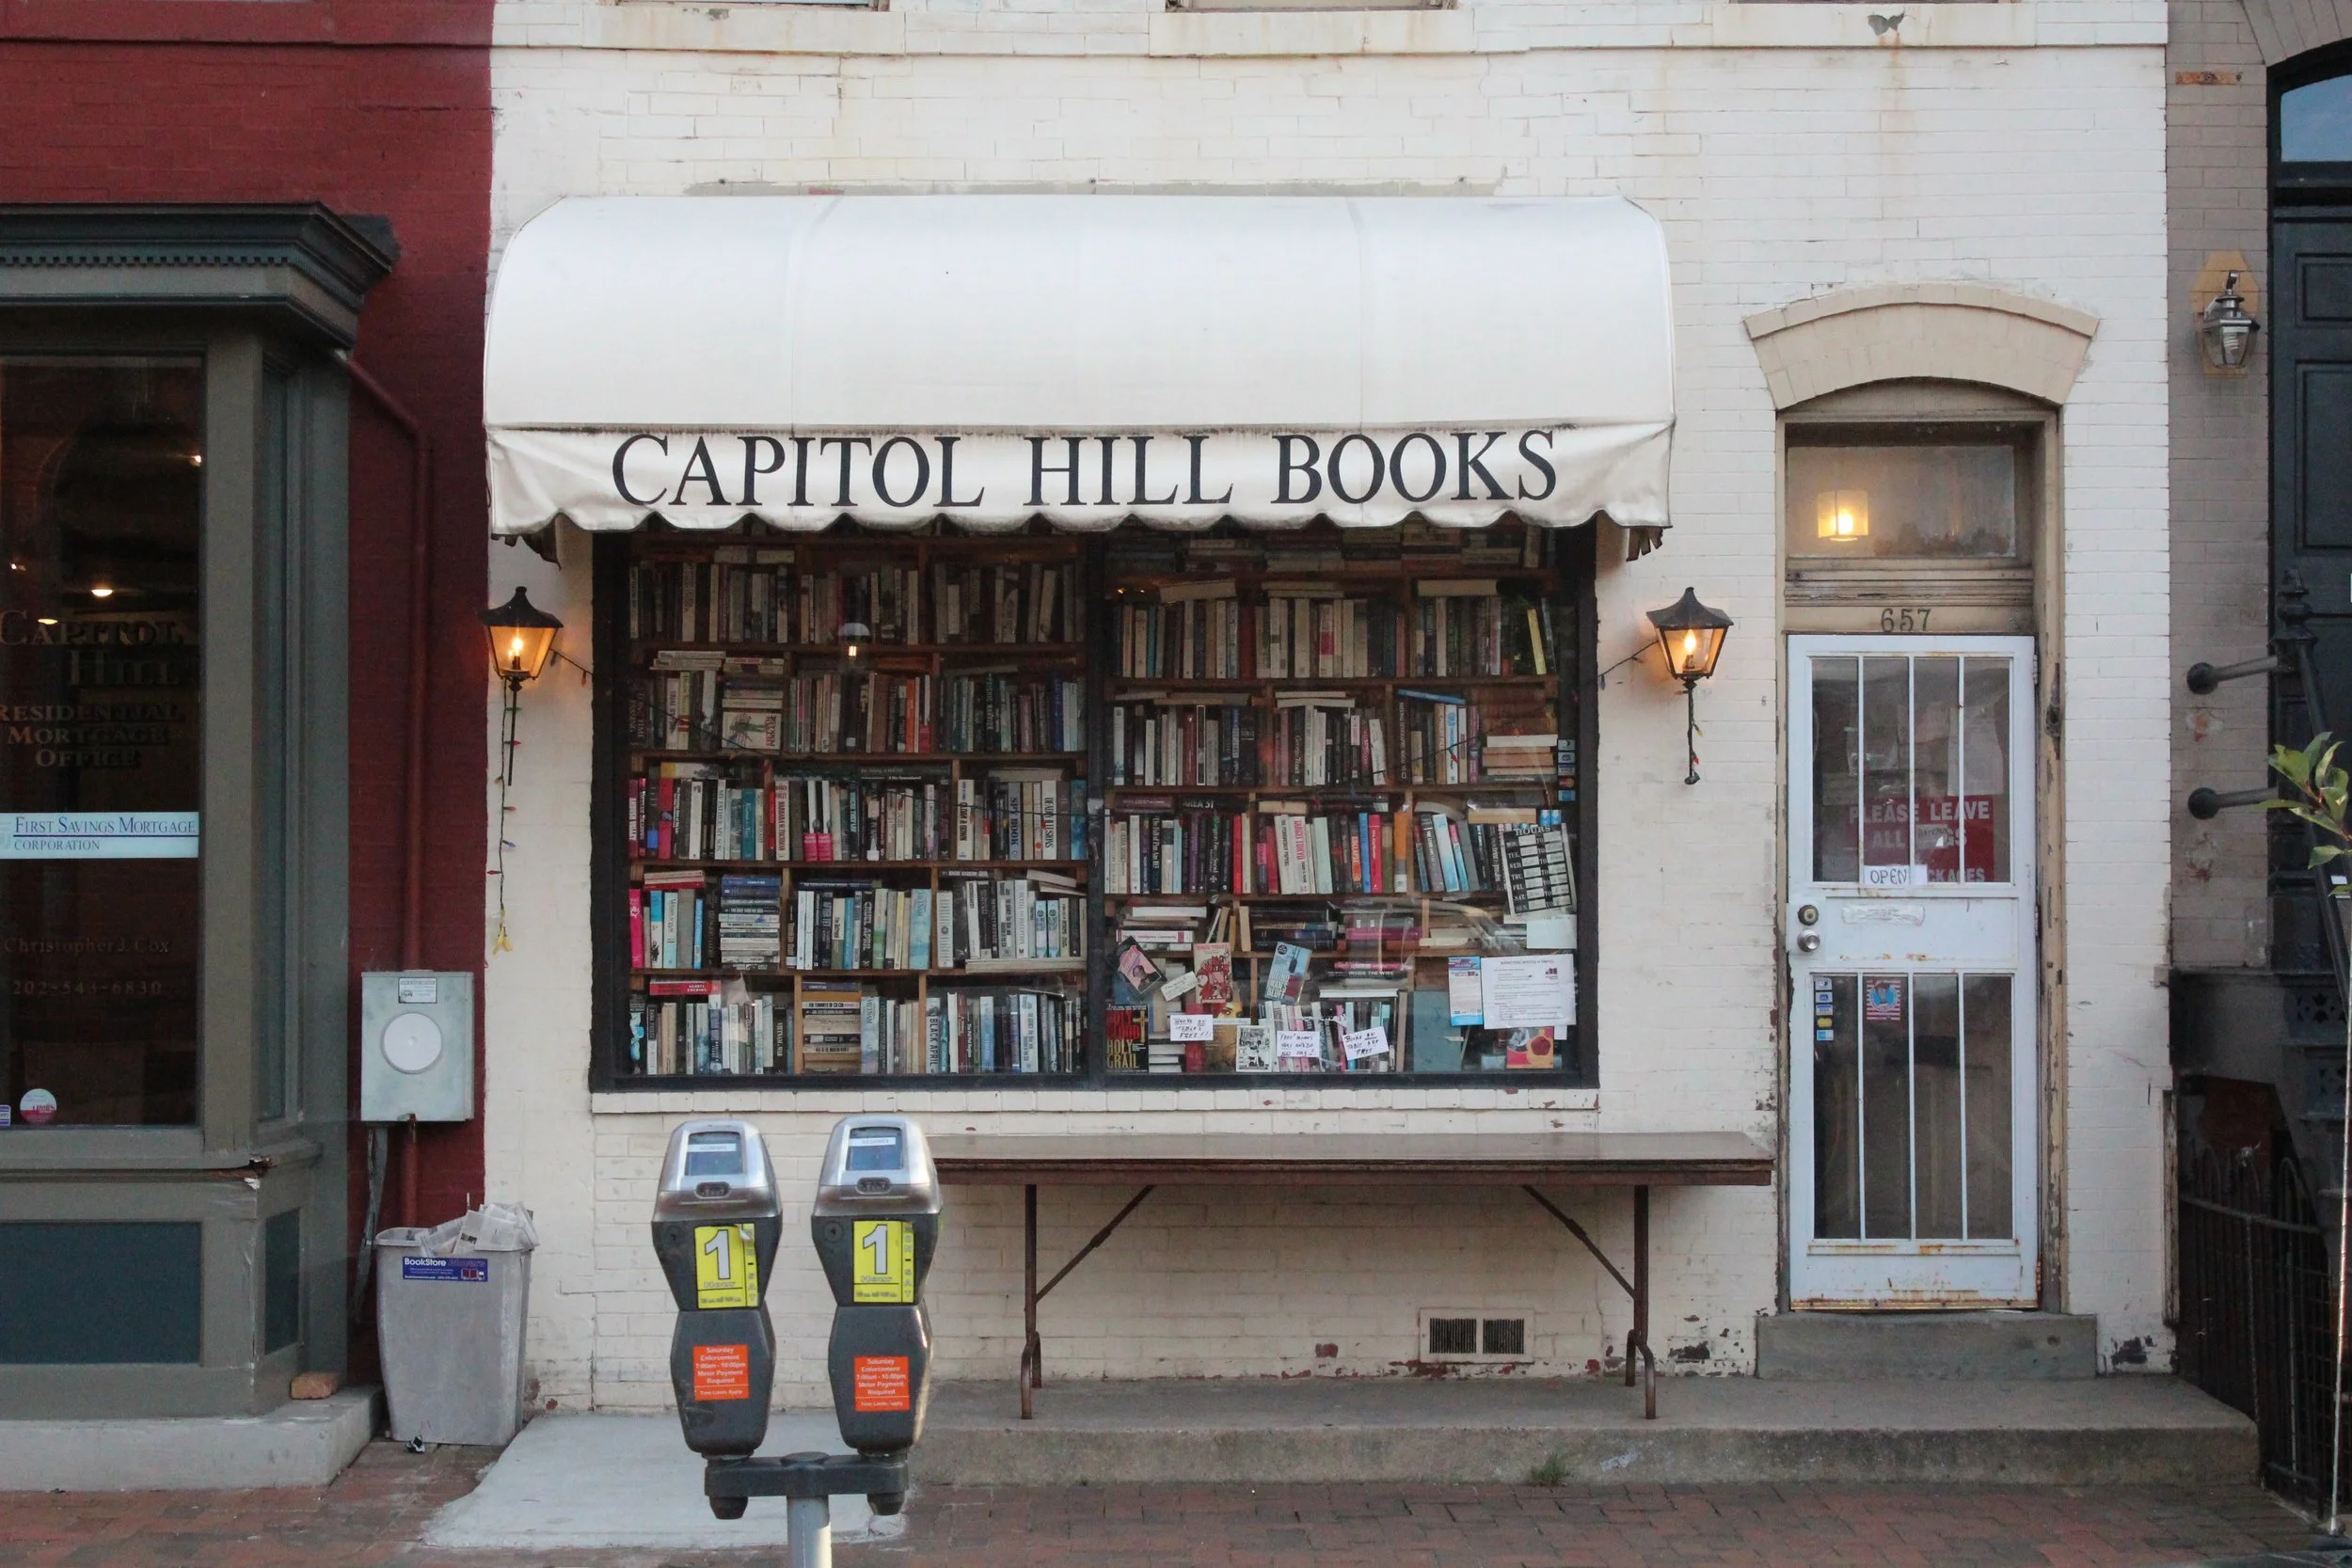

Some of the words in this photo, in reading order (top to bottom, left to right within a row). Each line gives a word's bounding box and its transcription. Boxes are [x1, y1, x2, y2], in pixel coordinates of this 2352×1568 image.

[612, 434, 985, 508] CAPITOL
[1023, 435, 1233, 506] HILL
[1270, 429, 1557, 504] BOOKS
[0, 610, 180, 646] CAPITOL
[1881, 608, 1931, 634] 657
[68, 648, 180, 687] HILL
[8, 725, 167, 745] MORTGAGE
[35, 749, 135, 768] OFFICE
[1009, 797, 1019, 816] SPY
[1931, 800, 1990, 821] LEAVE
[15, 816, 54, 833] FIRST
[58, 816, 115, 833] SAVINGS
[119, 816, 196, 833] MORTGAGE
[1009, 818, 1019, 846] BOOK
[1513, 825, 1551, 836] HOURS
[14, 840, 101, 851] CORPORATION
[1873, 829, 1905, 847] ALL
[1870, 868, 1908, 885] OPEN
[863, 901, 872, 926] CRUEL
[4, 937, 113, 956] Christopher
[135, 939, 170, 954] Cox
[863, 927, 871, 951] APRIL
[930, 1018, 939, 1041] BLACK
[929, 1044, 938, 1066] APRIL
[1106, 1039, 1133, 1053] HOLY
[1106, 1053, 1139, 1069] GRAIL
[705, 1229, 731, 1279] 1
[863, 1224, 887, 1275] 1
[405, 1257, 446, 1267] BookStore
